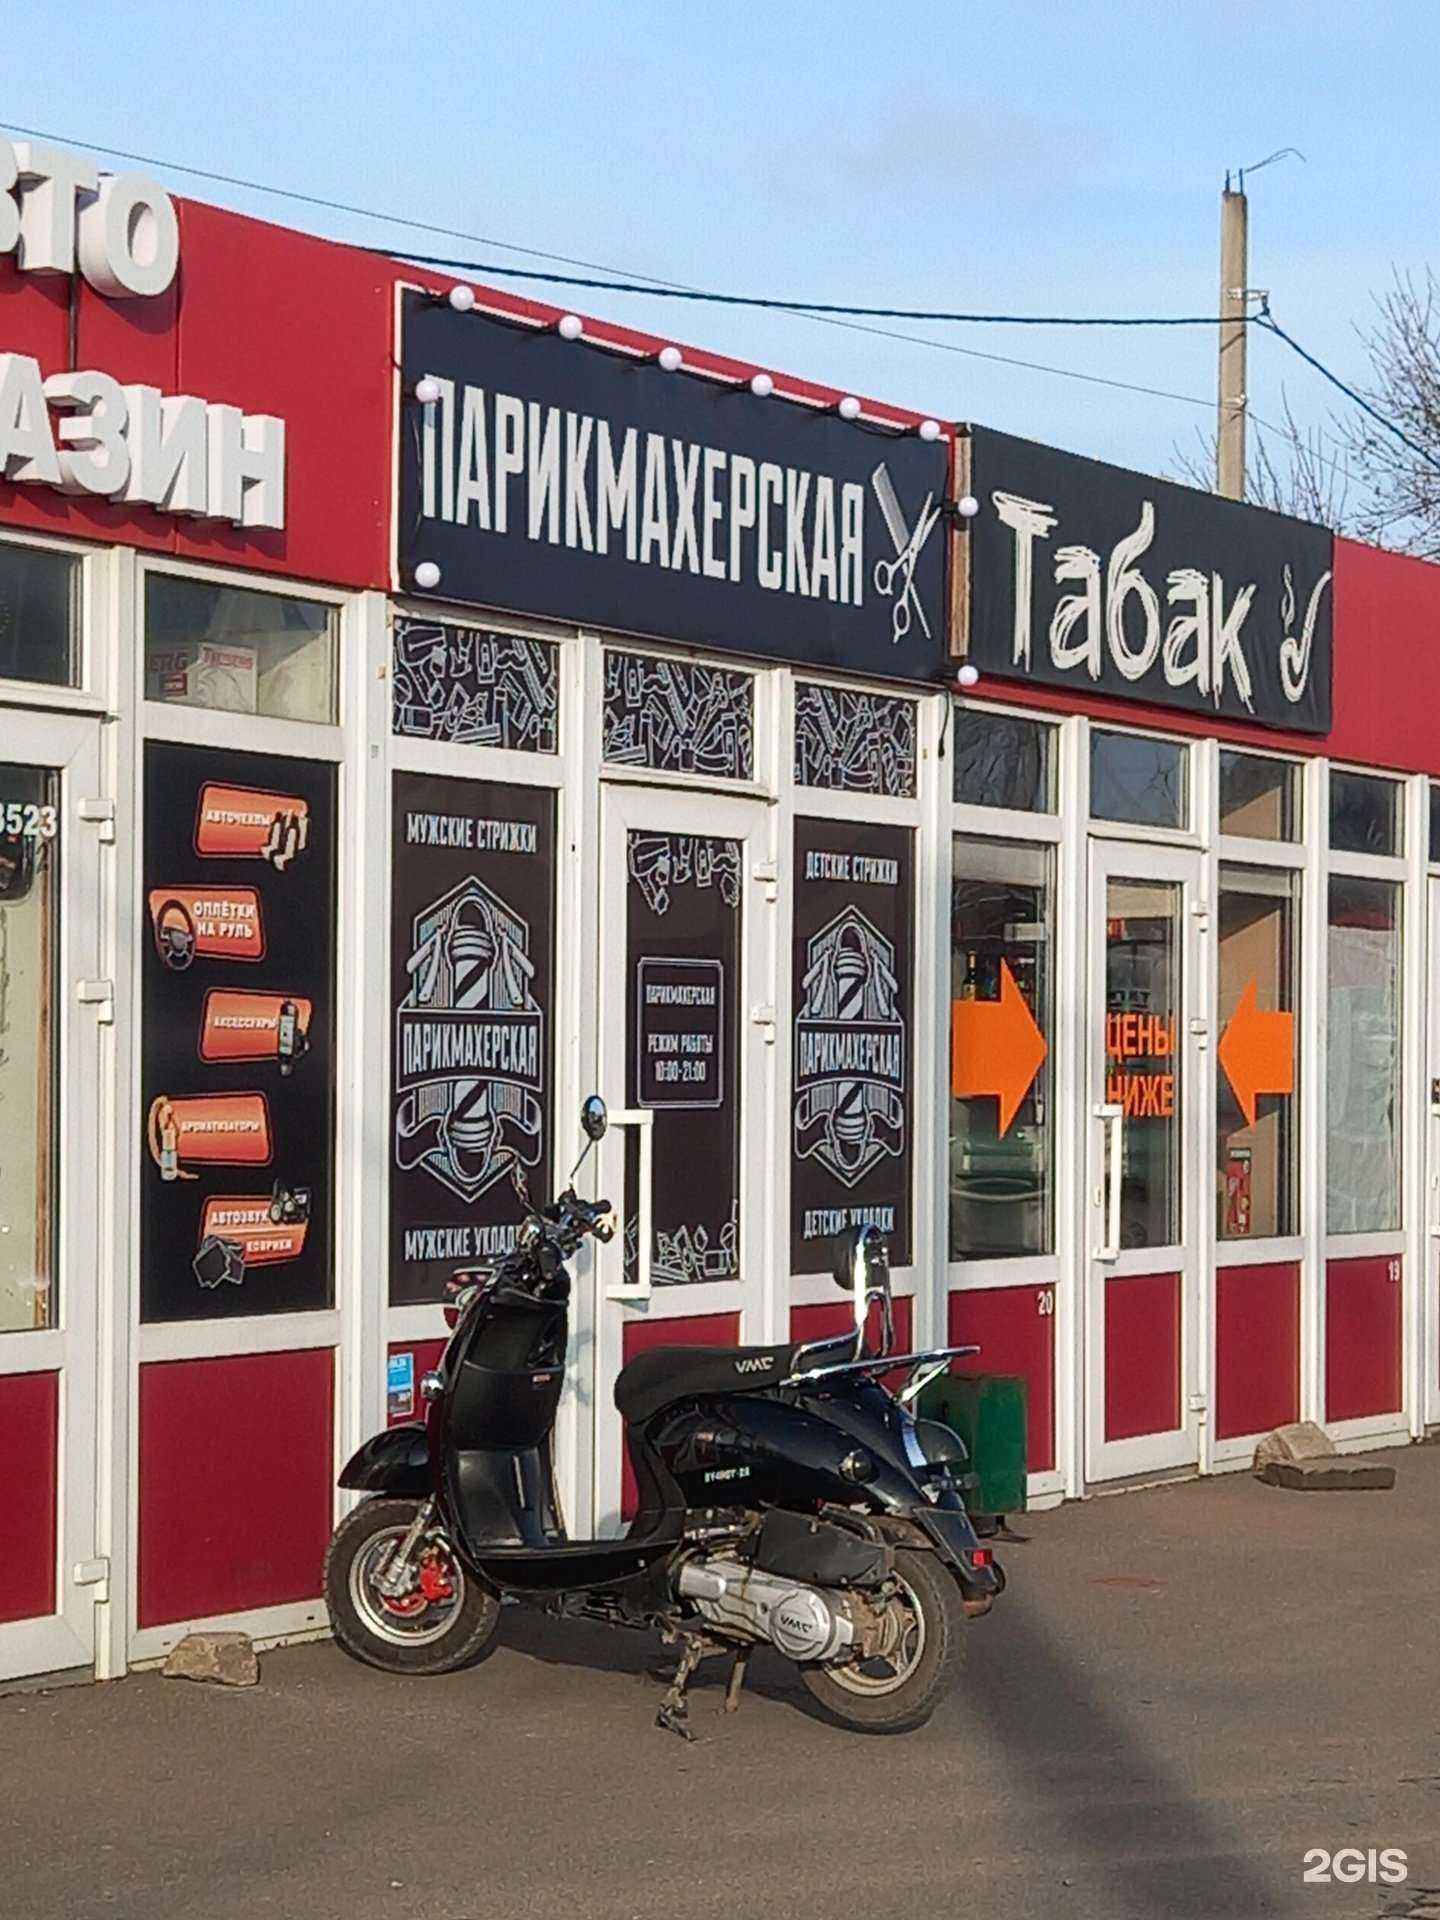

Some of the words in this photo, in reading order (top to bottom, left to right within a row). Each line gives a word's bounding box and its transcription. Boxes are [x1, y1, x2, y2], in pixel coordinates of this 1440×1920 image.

[423, 373, 864, 607] ПАРИКМАХЕРСКАЯ
[991, 490, 1257, 714] Табак
[0, 802, 57, 838] 523
[406, 812, 474, 849] МУЖСКИЕ
[477, 818, 537, 853] СТРИЖКИ
[805, 850, 850, 881] ДЕТСКИЕ
[852, 855, 898, 885] СТРИЖКИ
[193, 901, 256, 920] ОПЛЁТКИ
[198, 922, 216, 937] НА
[219, 923, 254, 939] РУЛЬ
[403, 1022, 538, 1078] ПАРИКМАХЕРСКАЯ
[800, 1030, 900, 1079] ПАРИКМАХЕРСКАЯ
[1106, 1012, 1175, 1064] ЦЕНЫ
[1107, 1073, 1175, 1117] НИЖЕ
[211, 1208, 270, 1226] АВТОЗВУК
[803, 1208, 848, 1240] ДЕТСКИЕ
[404, 1227, 471, 1261] МУЖСКИЕ
[1037, 1290, 1053, 1316] 20
[734, 1356, 774, 1374] VMC
[780, 1614, 813, 1633] VMC
